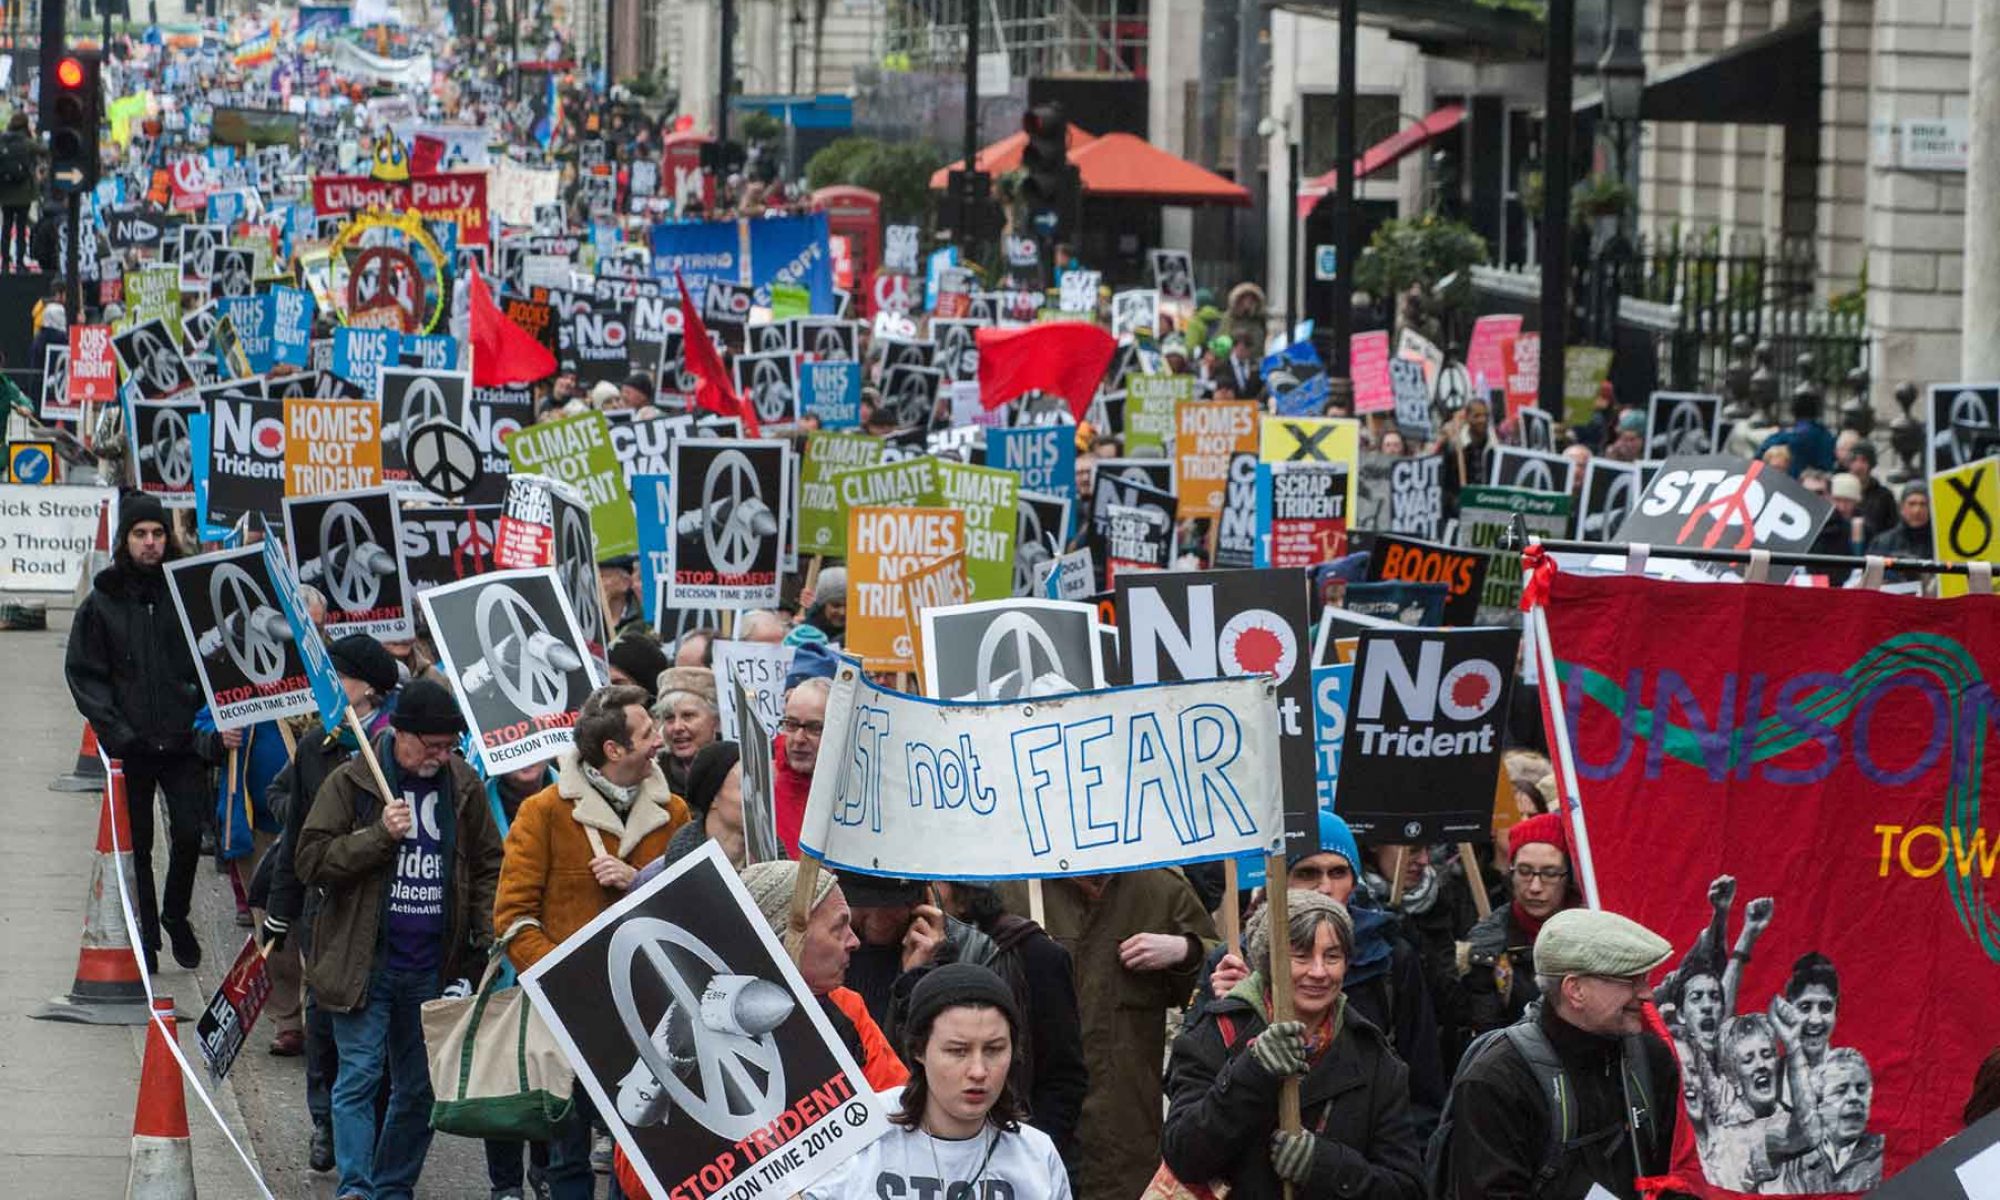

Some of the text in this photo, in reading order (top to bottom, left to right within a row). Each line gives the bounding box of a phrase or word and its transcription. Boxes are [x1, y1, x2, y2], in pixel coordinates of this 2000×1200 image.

[411, 180, 475, 208] Party
[706, 283, 750, 313] No
[229, 300, 265, 328] NHS
[635, 297, 684, 333] No
[79, 327, 107, 350] JOBS
[575, 312, 627, 347] No
[82, 348, 105, 362] NOT
[242, 336, 271, 354] DENT
[347, 331, 388, 362] NHS
[73, 360, 113, 379] TRIDENT
[349, 360, 377, 377] NO
[812, 366, 849, 391] NHS
[472, 386, 531, 404] Trident
[214, 401, 285, 459] No
[291, 406, 374, 443] HOMES
[612, 415, 695, 456] CUT
[1182, 405, 1252, 436] HOMES
[308, 441, 356, 465] NOT
[515, 416, 604, 468] CLIMATE
[809, 436, 879, 468] CLIMATE
[1005, 432, 1060, 470] NHS
[1196, 434, 1236, 453] NOT
[215, 451, 285, 480] Trident
[293, 464, 374, 494] TRIDENT
[543, 452, 592, 481] NOT
[1392, 456, 1444, 491] CUT
[508, 480, 550, 507] SCRA
[842, 464, 935, 507] CLIMATE
[1275, 474, 1333, 497] SCRAP
[0, 500, 101, 518] rick Street
[507, 497, 552, 527] TRIDE
[1274, 494, 1344, 518] TRIDENT
[1393, 486, 1442, 519] WAR
[1642, 469, 1812, 544] STOP
[15, 533, 97, 553] Through
[401, 519, 500, 558] STO
[856, 513, 956, 555] HOMES
[11, 557, 66, 574] Road
[675, 570, 776, 586] STOP TRIDENT
[1381, 543, 1476, 597] BOOKS
[674, 586, 763, 600] DECISION TIME 2016
[908, 560, 964, 627] HOMES
[342, 605, 405, 623] TRIDENT
[348, 623, 369, 635] TIME
[371, 622, 392, 634] 2016
[1127, 584, 1298, 687] No
[1357, 638, 1503, 722] No
[214, 683, 253, 708] STOP
[219, 693, 308, 721] DECISION TIME 2016
[482, 720, 530, 748] STOP
[489, 729, 571, 764] DECISION TIME
[1355, 723, 1496, 758] Trident
[904, 734, 997, 815] not
[1010, 703, 1259, 858] FEAR
[669, 1072, 853, 1200] STOP TRIDENT
[759, 1147, 805, 1184] TIME
[801, 1119, 844, 1158] 2016
